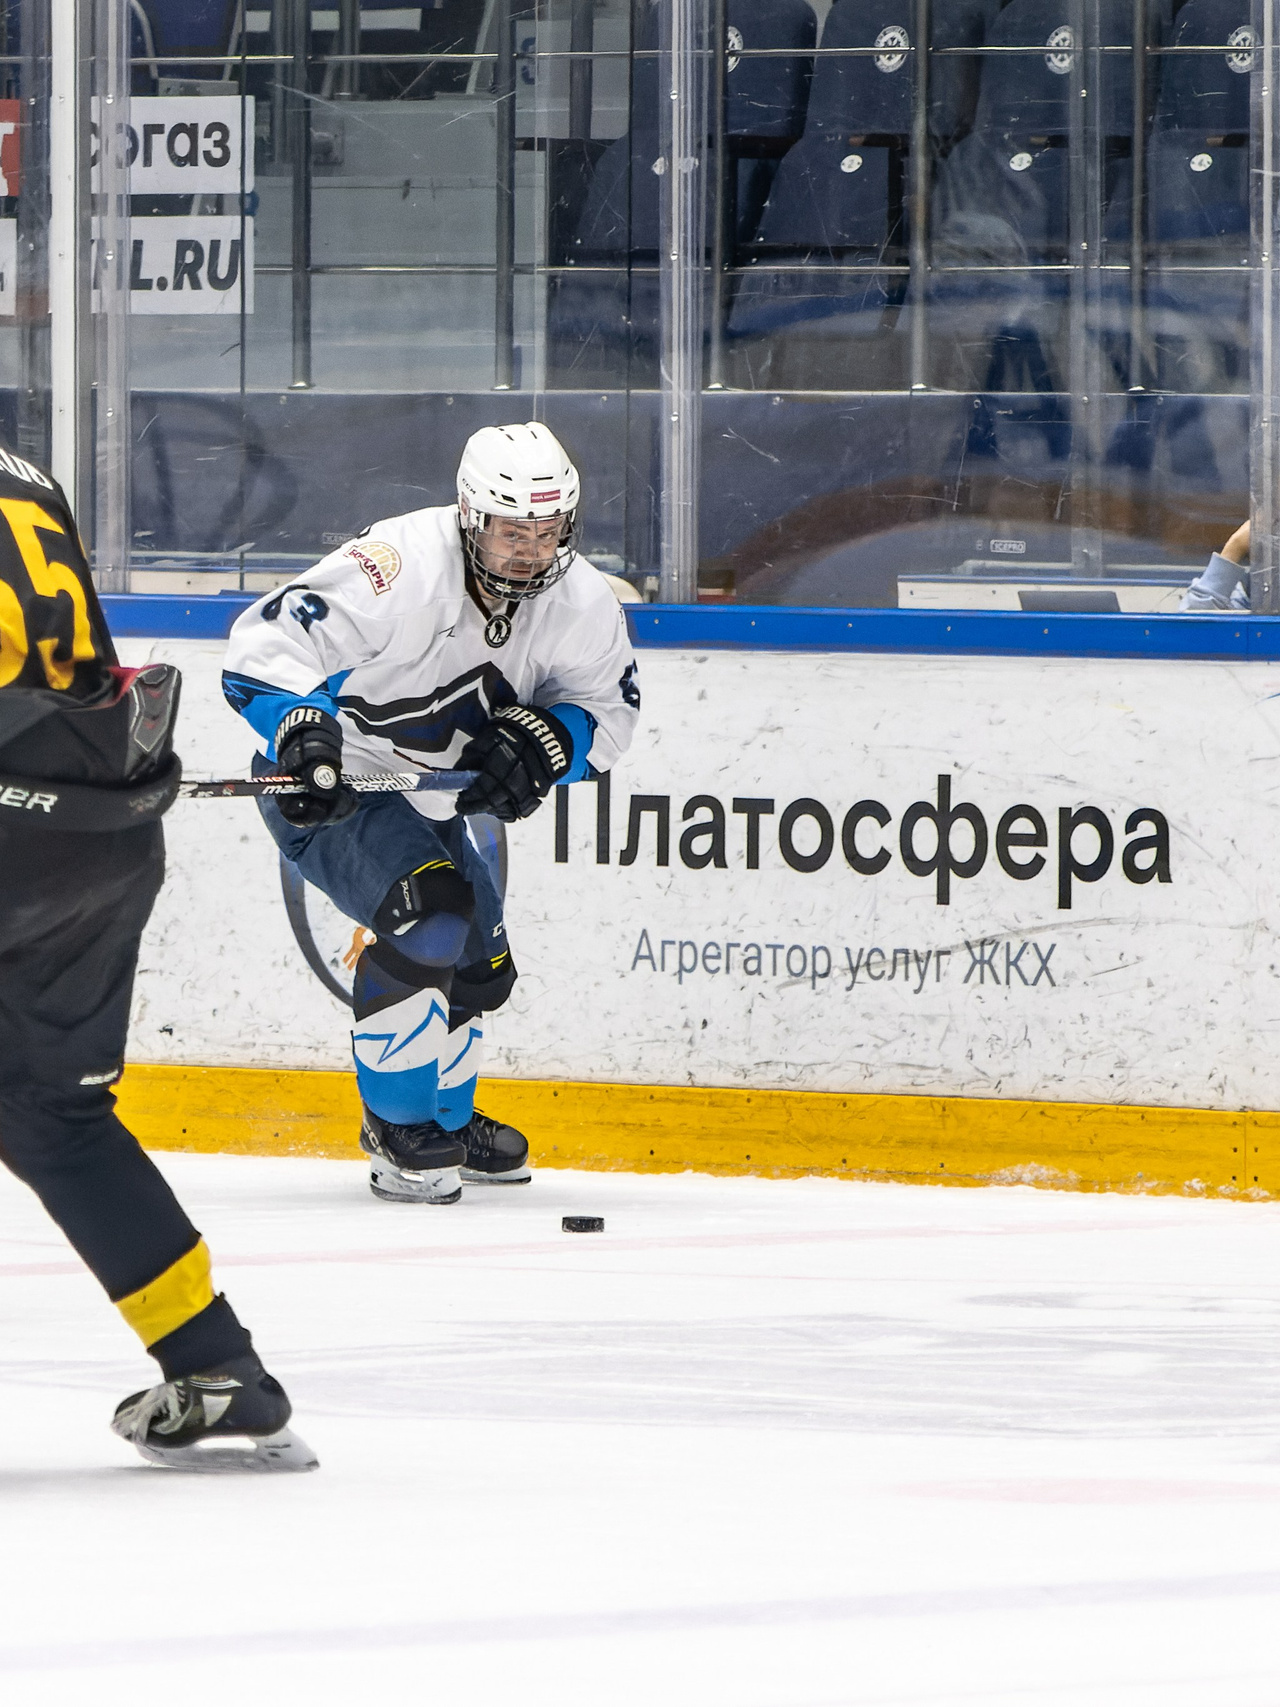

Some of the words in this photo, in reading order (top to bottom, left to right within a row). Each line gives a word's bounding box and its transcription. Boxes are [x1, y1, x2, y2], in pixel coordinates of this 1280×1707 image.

[91, 121, 231, 168] огаз
[554, 771, 1174, 910] Платосфера
[631, 928, 832, 985] Агрегатор
[845, 944, 951, 994] услуг
[963, 940, 1057, 988] ЖКХ
